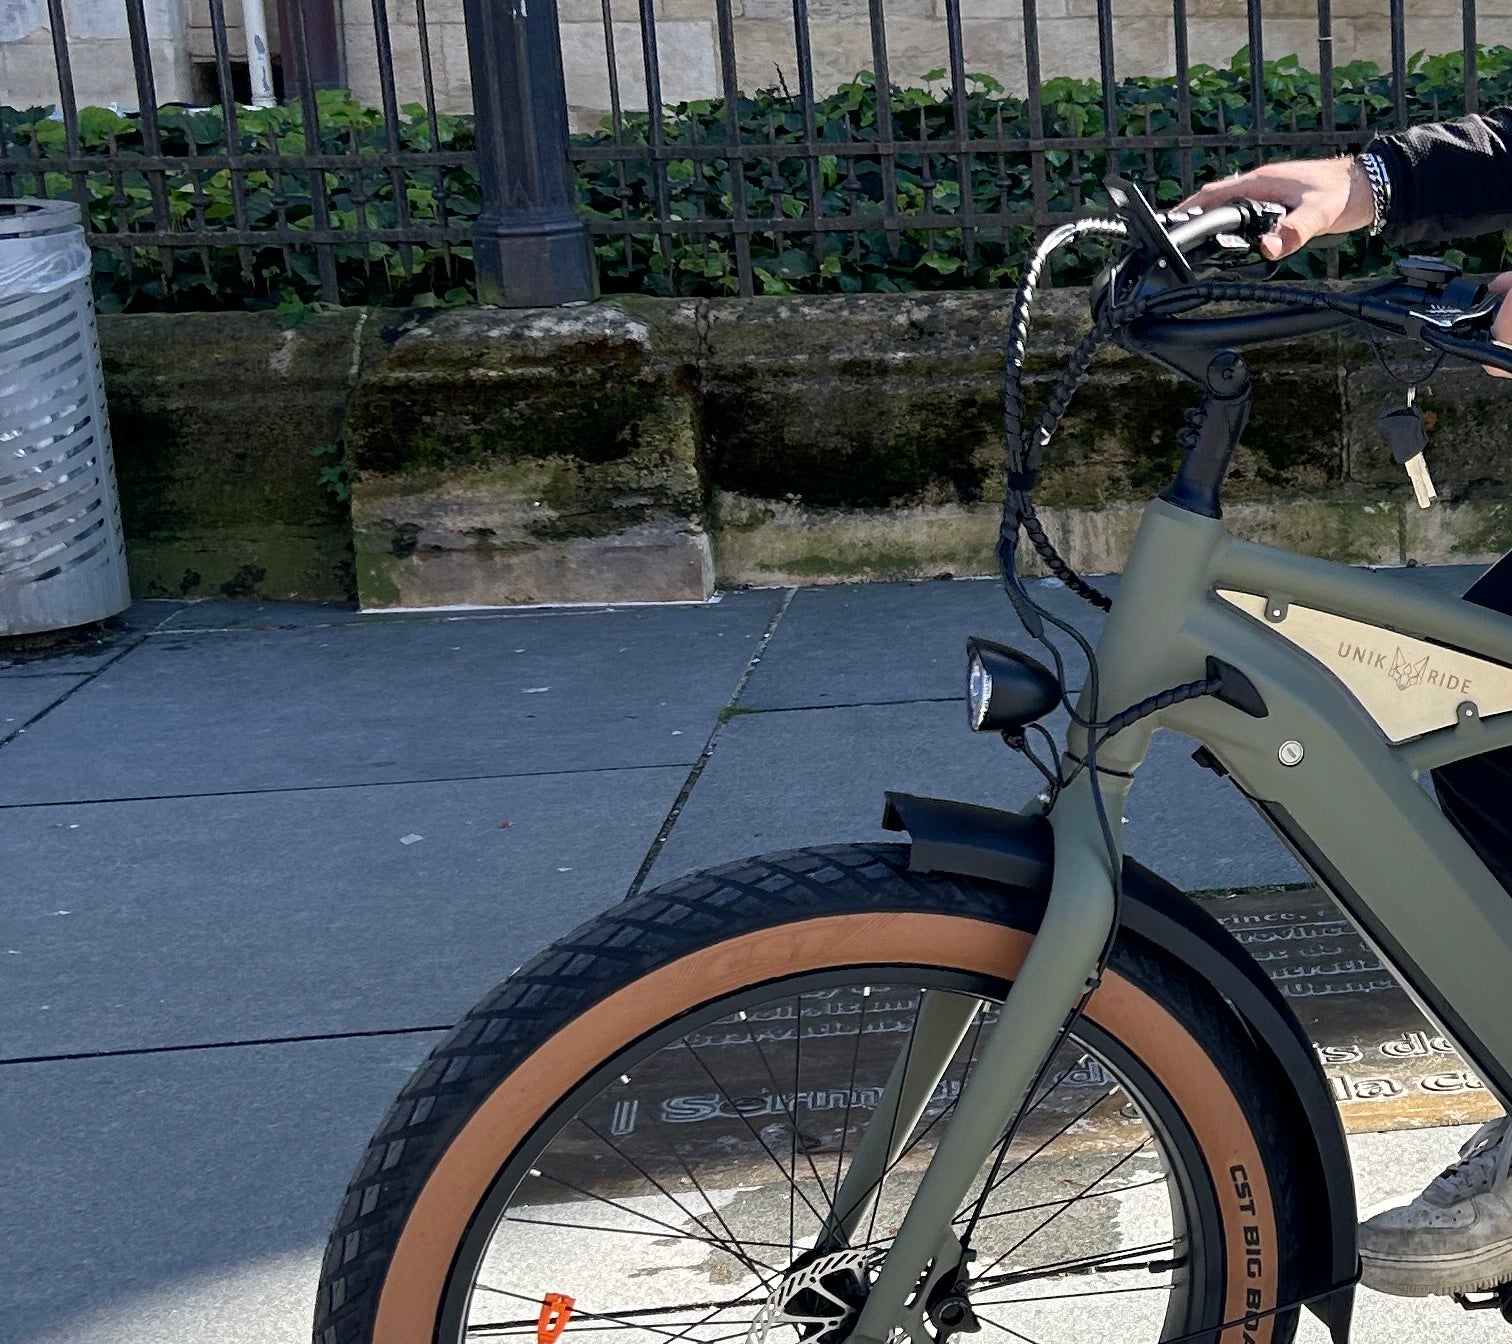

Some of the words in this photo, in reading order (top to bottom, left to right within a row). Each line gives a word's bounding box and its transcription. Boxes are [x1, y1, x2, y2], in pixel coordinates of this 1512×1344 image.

[1337, 641, 1387, 671] UNIK
[1427, 669, 1473, 695] RIDE
[1229, 1163, 1256, 1216] CST
[1243, 1225, 1262, 1278] BIG
